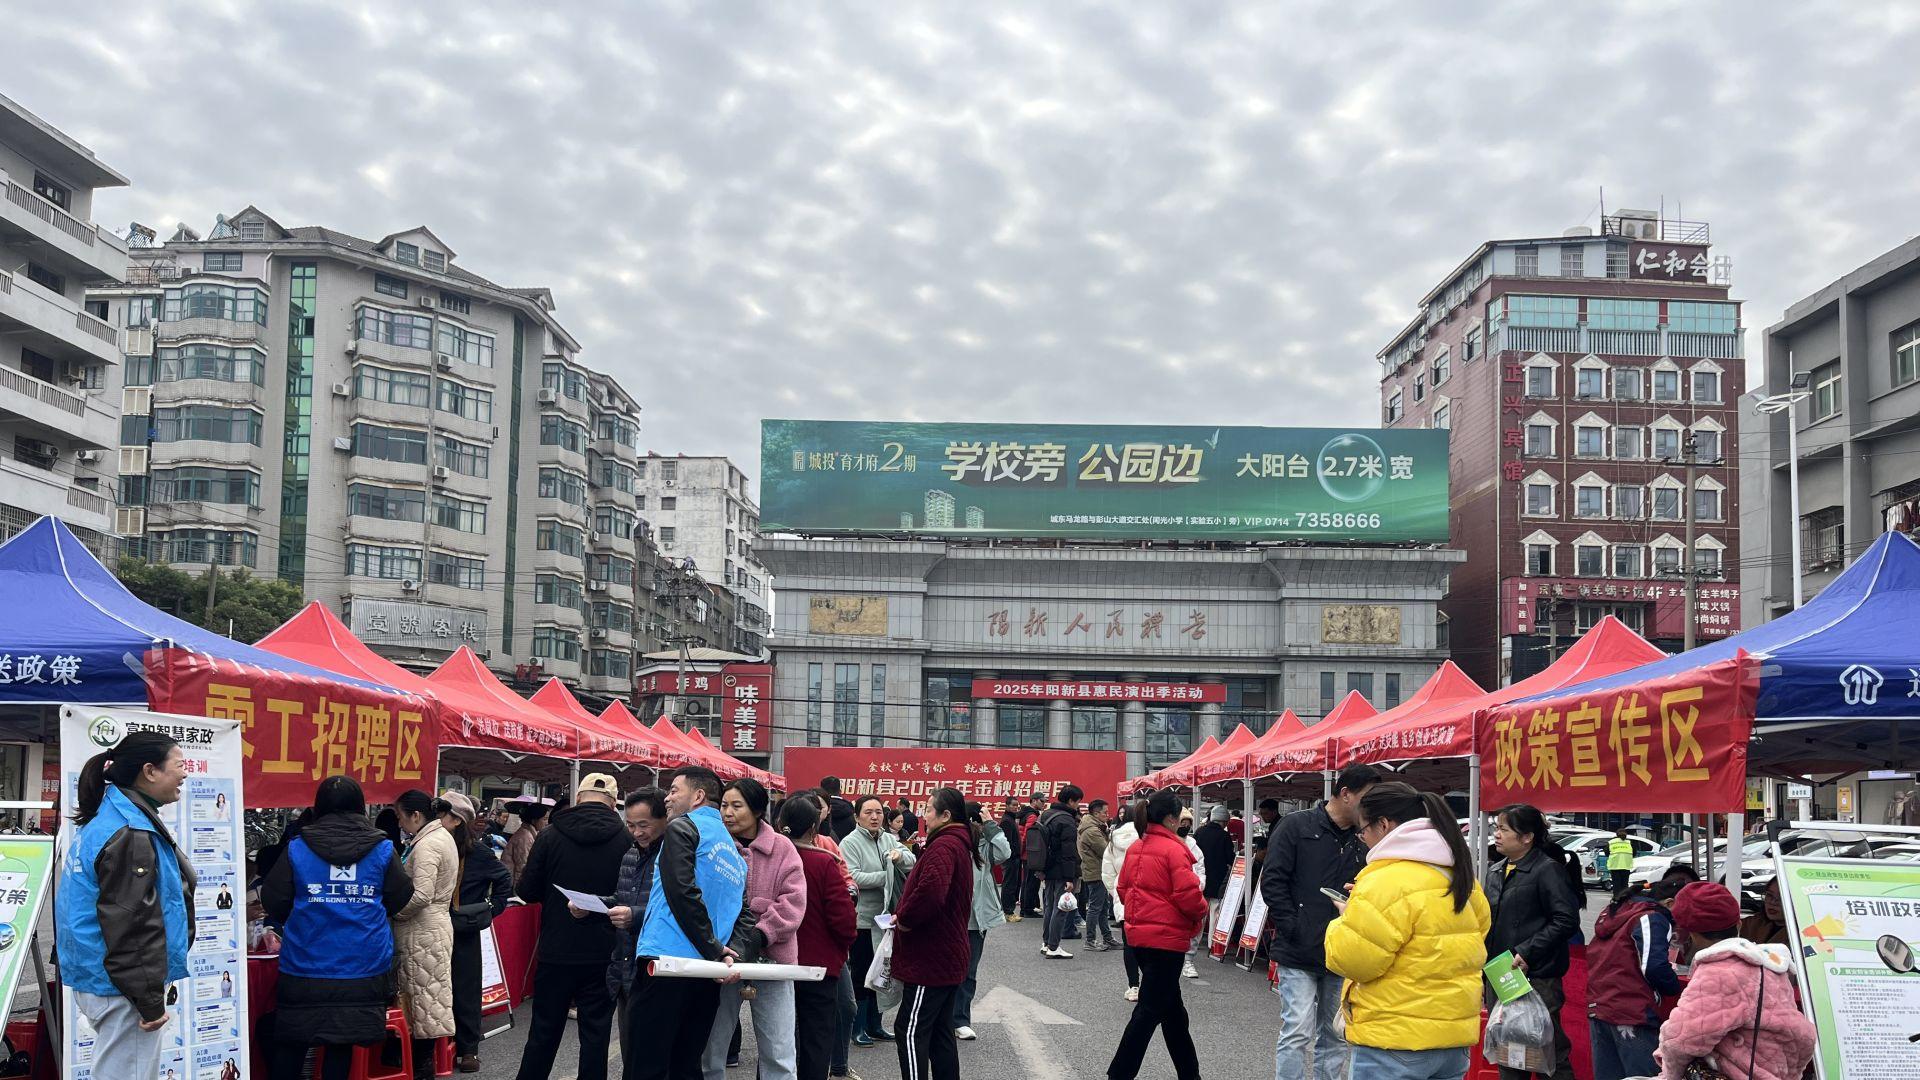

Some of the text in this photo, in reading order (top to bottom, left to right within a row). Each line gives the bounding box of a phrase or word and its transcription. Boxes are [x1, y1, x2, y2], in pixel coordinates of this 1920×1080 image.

[941, 441, 1204, 483] 学校旁 公园边
[1236, 453, 1414, 480] 大阳台 2.7米 宽
[1244, 517, 1262, 527] VIP
[1264, 518, 1290, 528] 0714
[1295, 512, 1381, 529] 7358666
[993, 683, 1204, 700] 2025年阳新县惠民演出季活动
[733, 684, 760, 750] 味美基
[1494, 686, 1710, 791] 政策宣传区
[307, 883, 376, 896] 零工驿站
